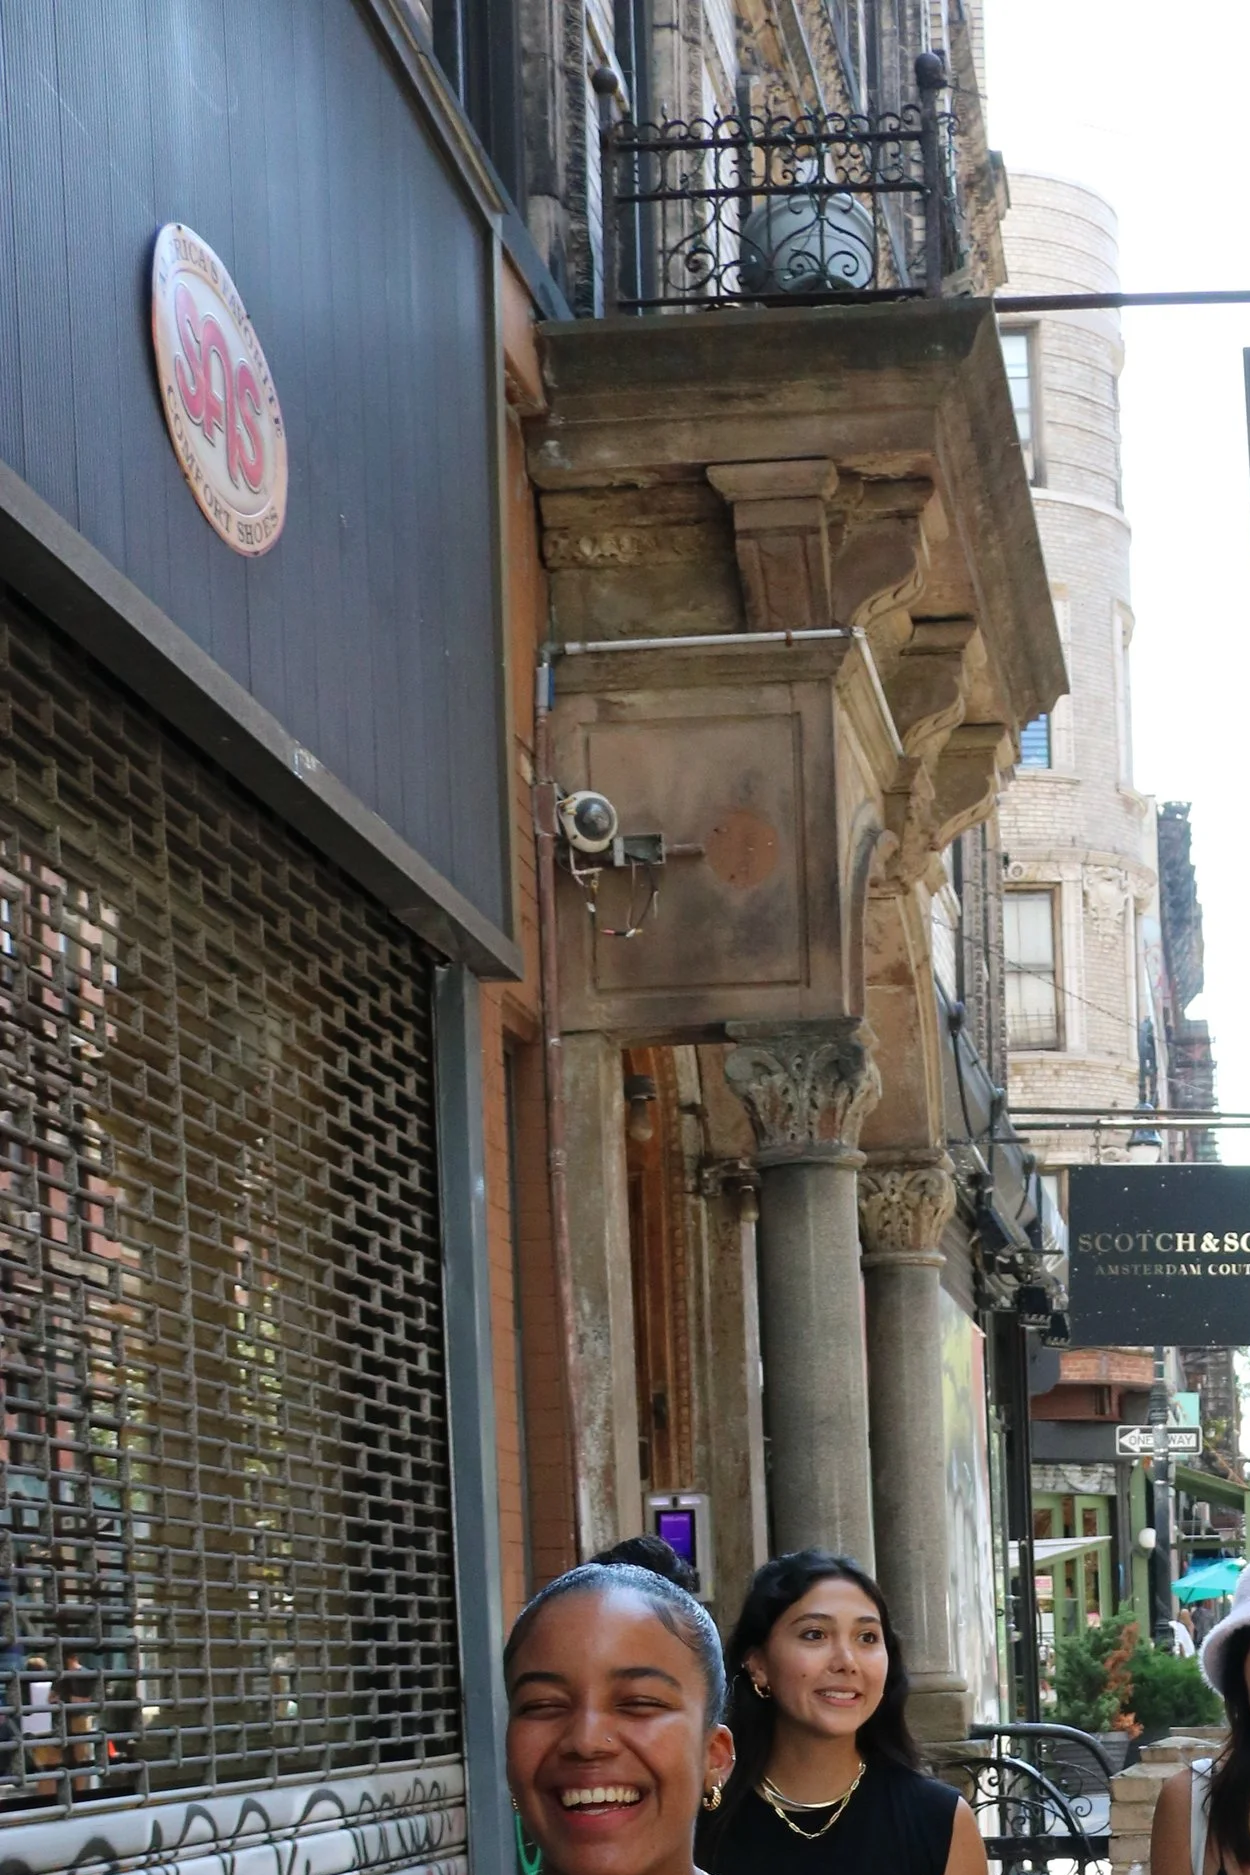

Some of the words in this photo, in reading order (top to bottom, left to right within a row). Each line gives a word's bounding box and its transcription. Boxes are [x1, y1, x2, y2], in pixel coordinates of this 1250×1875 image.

[174, 280, 265, 494] SAS
[237, 506, 278, 545] SHOES
[1095, 1263, 1201, 1276] AMSTERDAM
[1128, 1435, 1154, 1446] ONE
[1167, 1434, 1192, 1445] WAY
